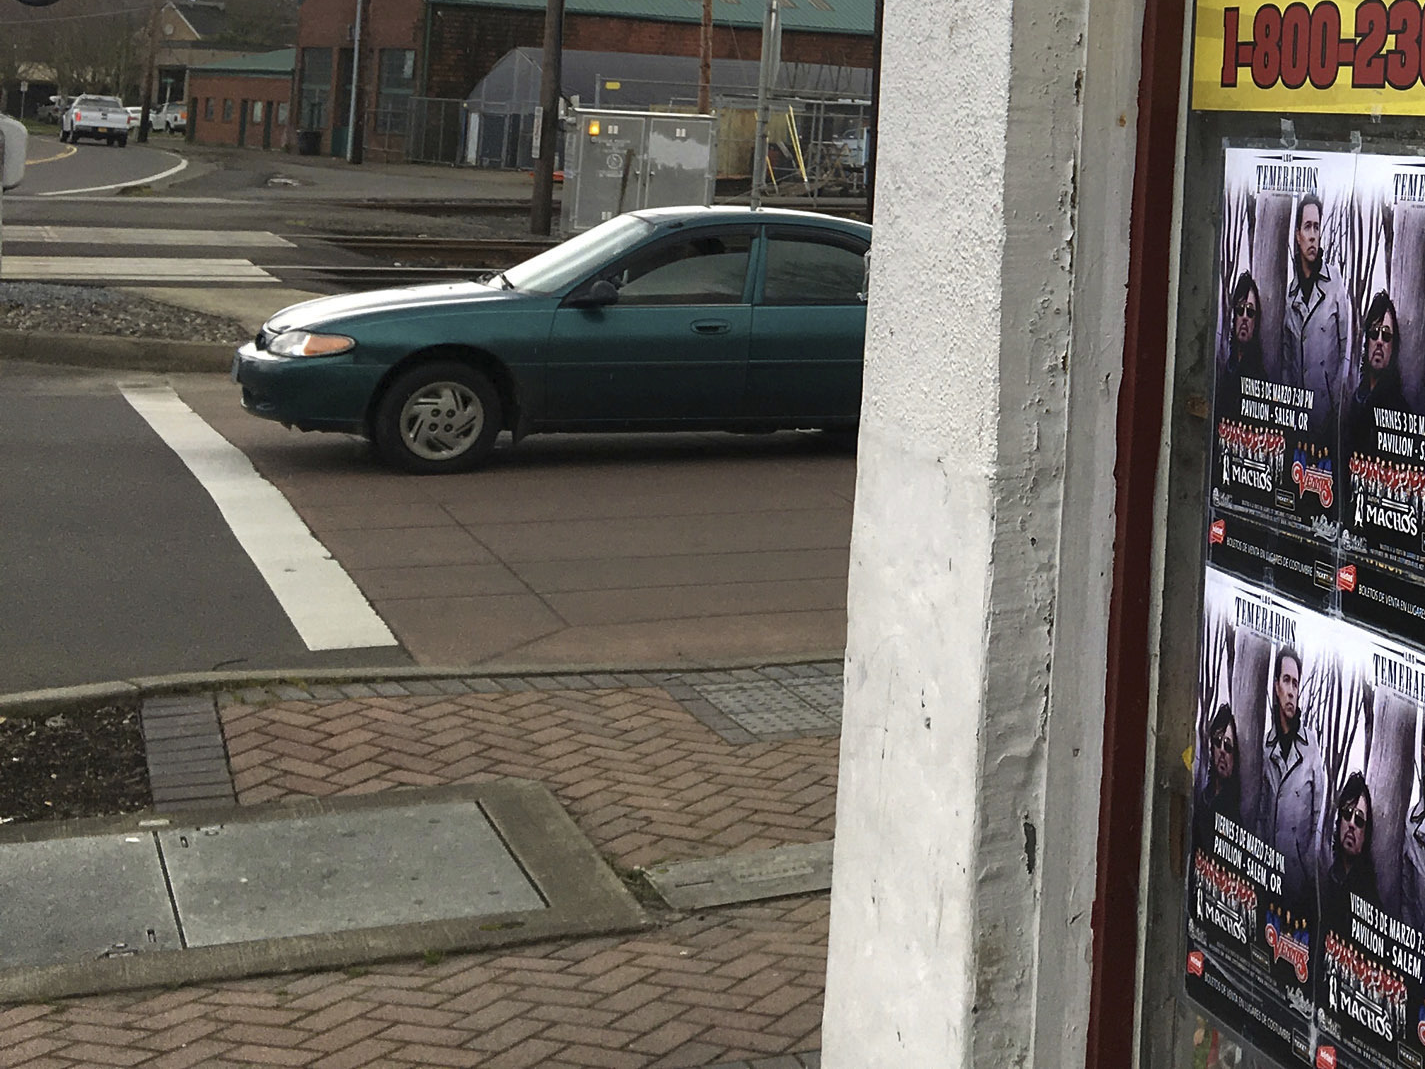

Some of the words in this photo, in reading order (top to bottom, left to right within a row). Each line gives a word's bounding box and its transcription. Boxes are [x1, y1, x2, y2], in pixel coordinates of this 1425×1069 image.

[1257, 165, 1319, 197] TEMERARIOS
[1241, 399, 1269, 421] PAVILION
[1298, 412, 1308, 431] OR
[1304, 390, 1314, 409] PM
[1374, 407, 1401, 431] VIERNES
[1403, 413, 1407, 432] 3
[1408, 414, 1417, 434] DE
[1378, 432, 1413, 457] PAVILION
[1367, 505, 1417, 536] MACHOS
[1235, 597, 1296, 649] TEMERARIOS
[1214, 836, 1242, 869] PAVILION
[1270, 873, 1282, 895] OR
[1350, 892, 1374, 925] VIERNES
[1374, 908, 1379, 930] 3
[1379, 911, 1388, 935] DE
[1389, 917, 1416, 951] MARZO
[1352, 918, 1384, 958] PAVILION
[1392, 946, 1423, 984] SALEM,
[1340, 991, 1393, 1042] MACHOS
